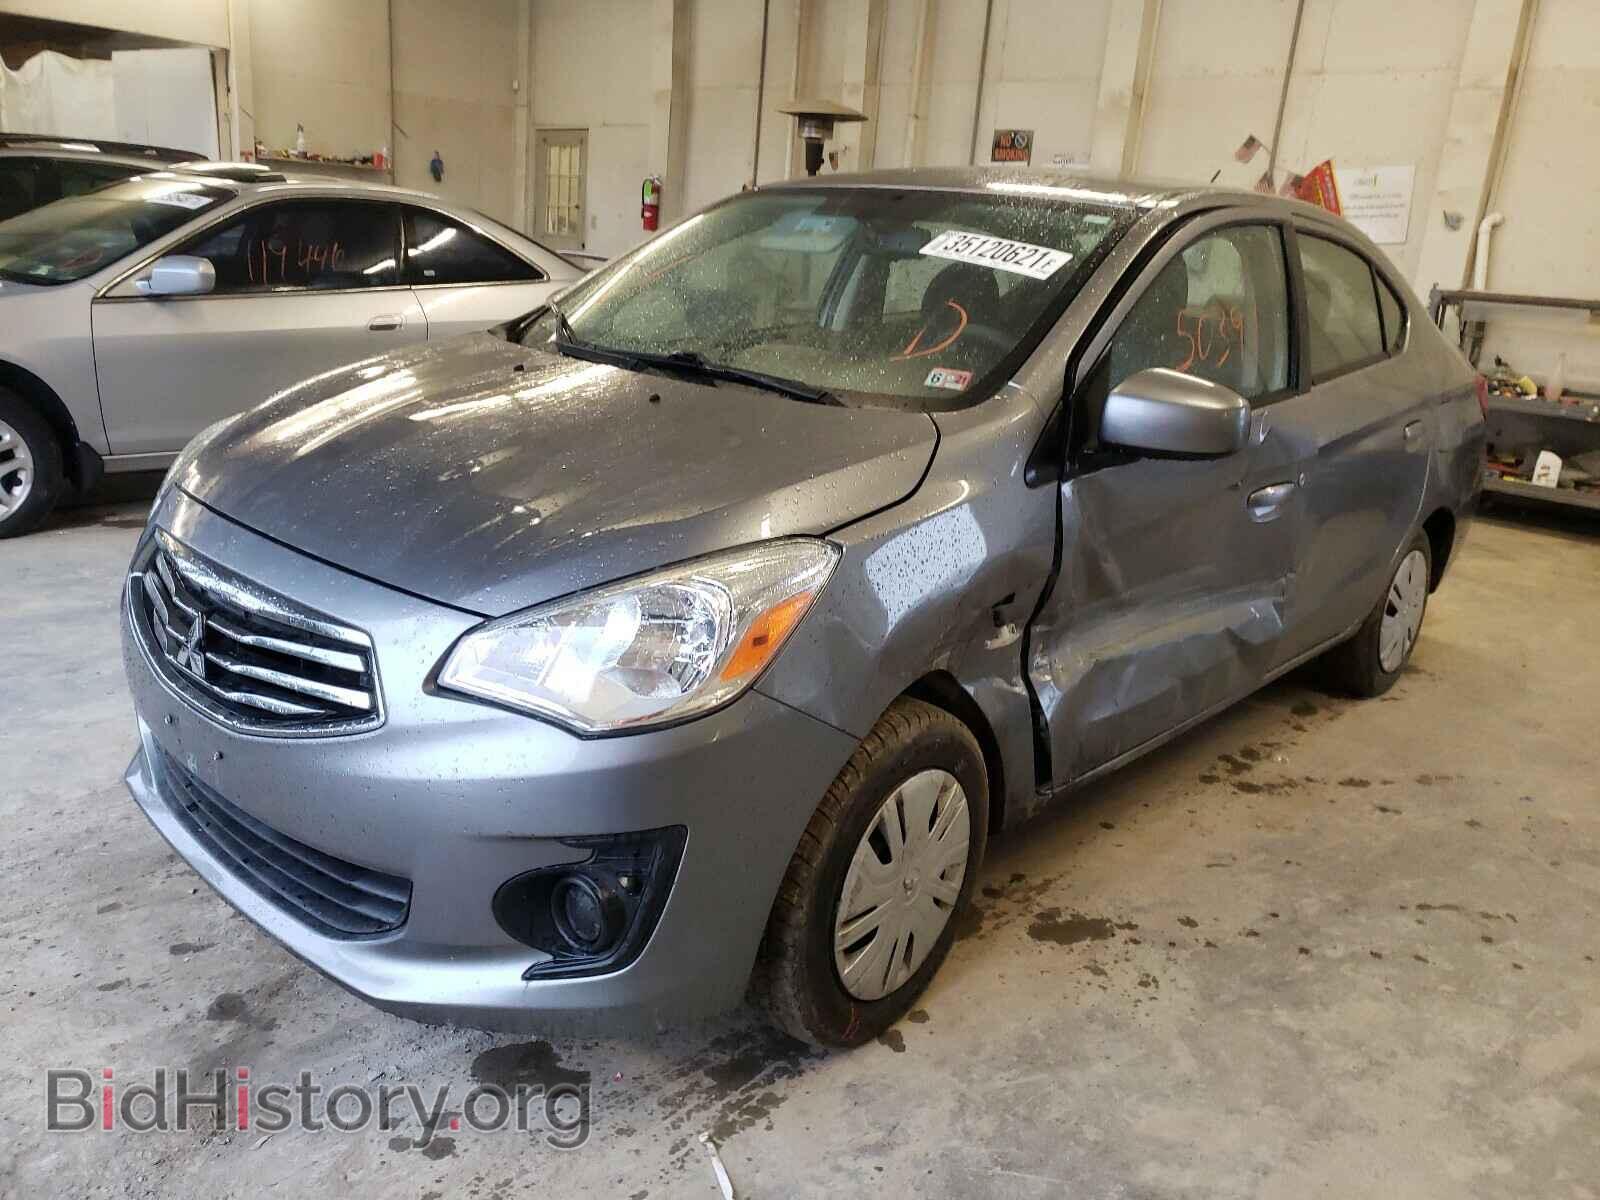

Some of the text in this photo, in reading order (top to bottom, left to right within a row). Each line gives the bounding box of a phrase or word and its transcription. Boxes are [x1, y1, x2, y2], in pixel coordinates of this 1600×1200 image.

[1000, 135, 1012, 147] NO
[994, 147, 1029, 161] SMOKING
[943, 234, 1051, 269] 35120621
